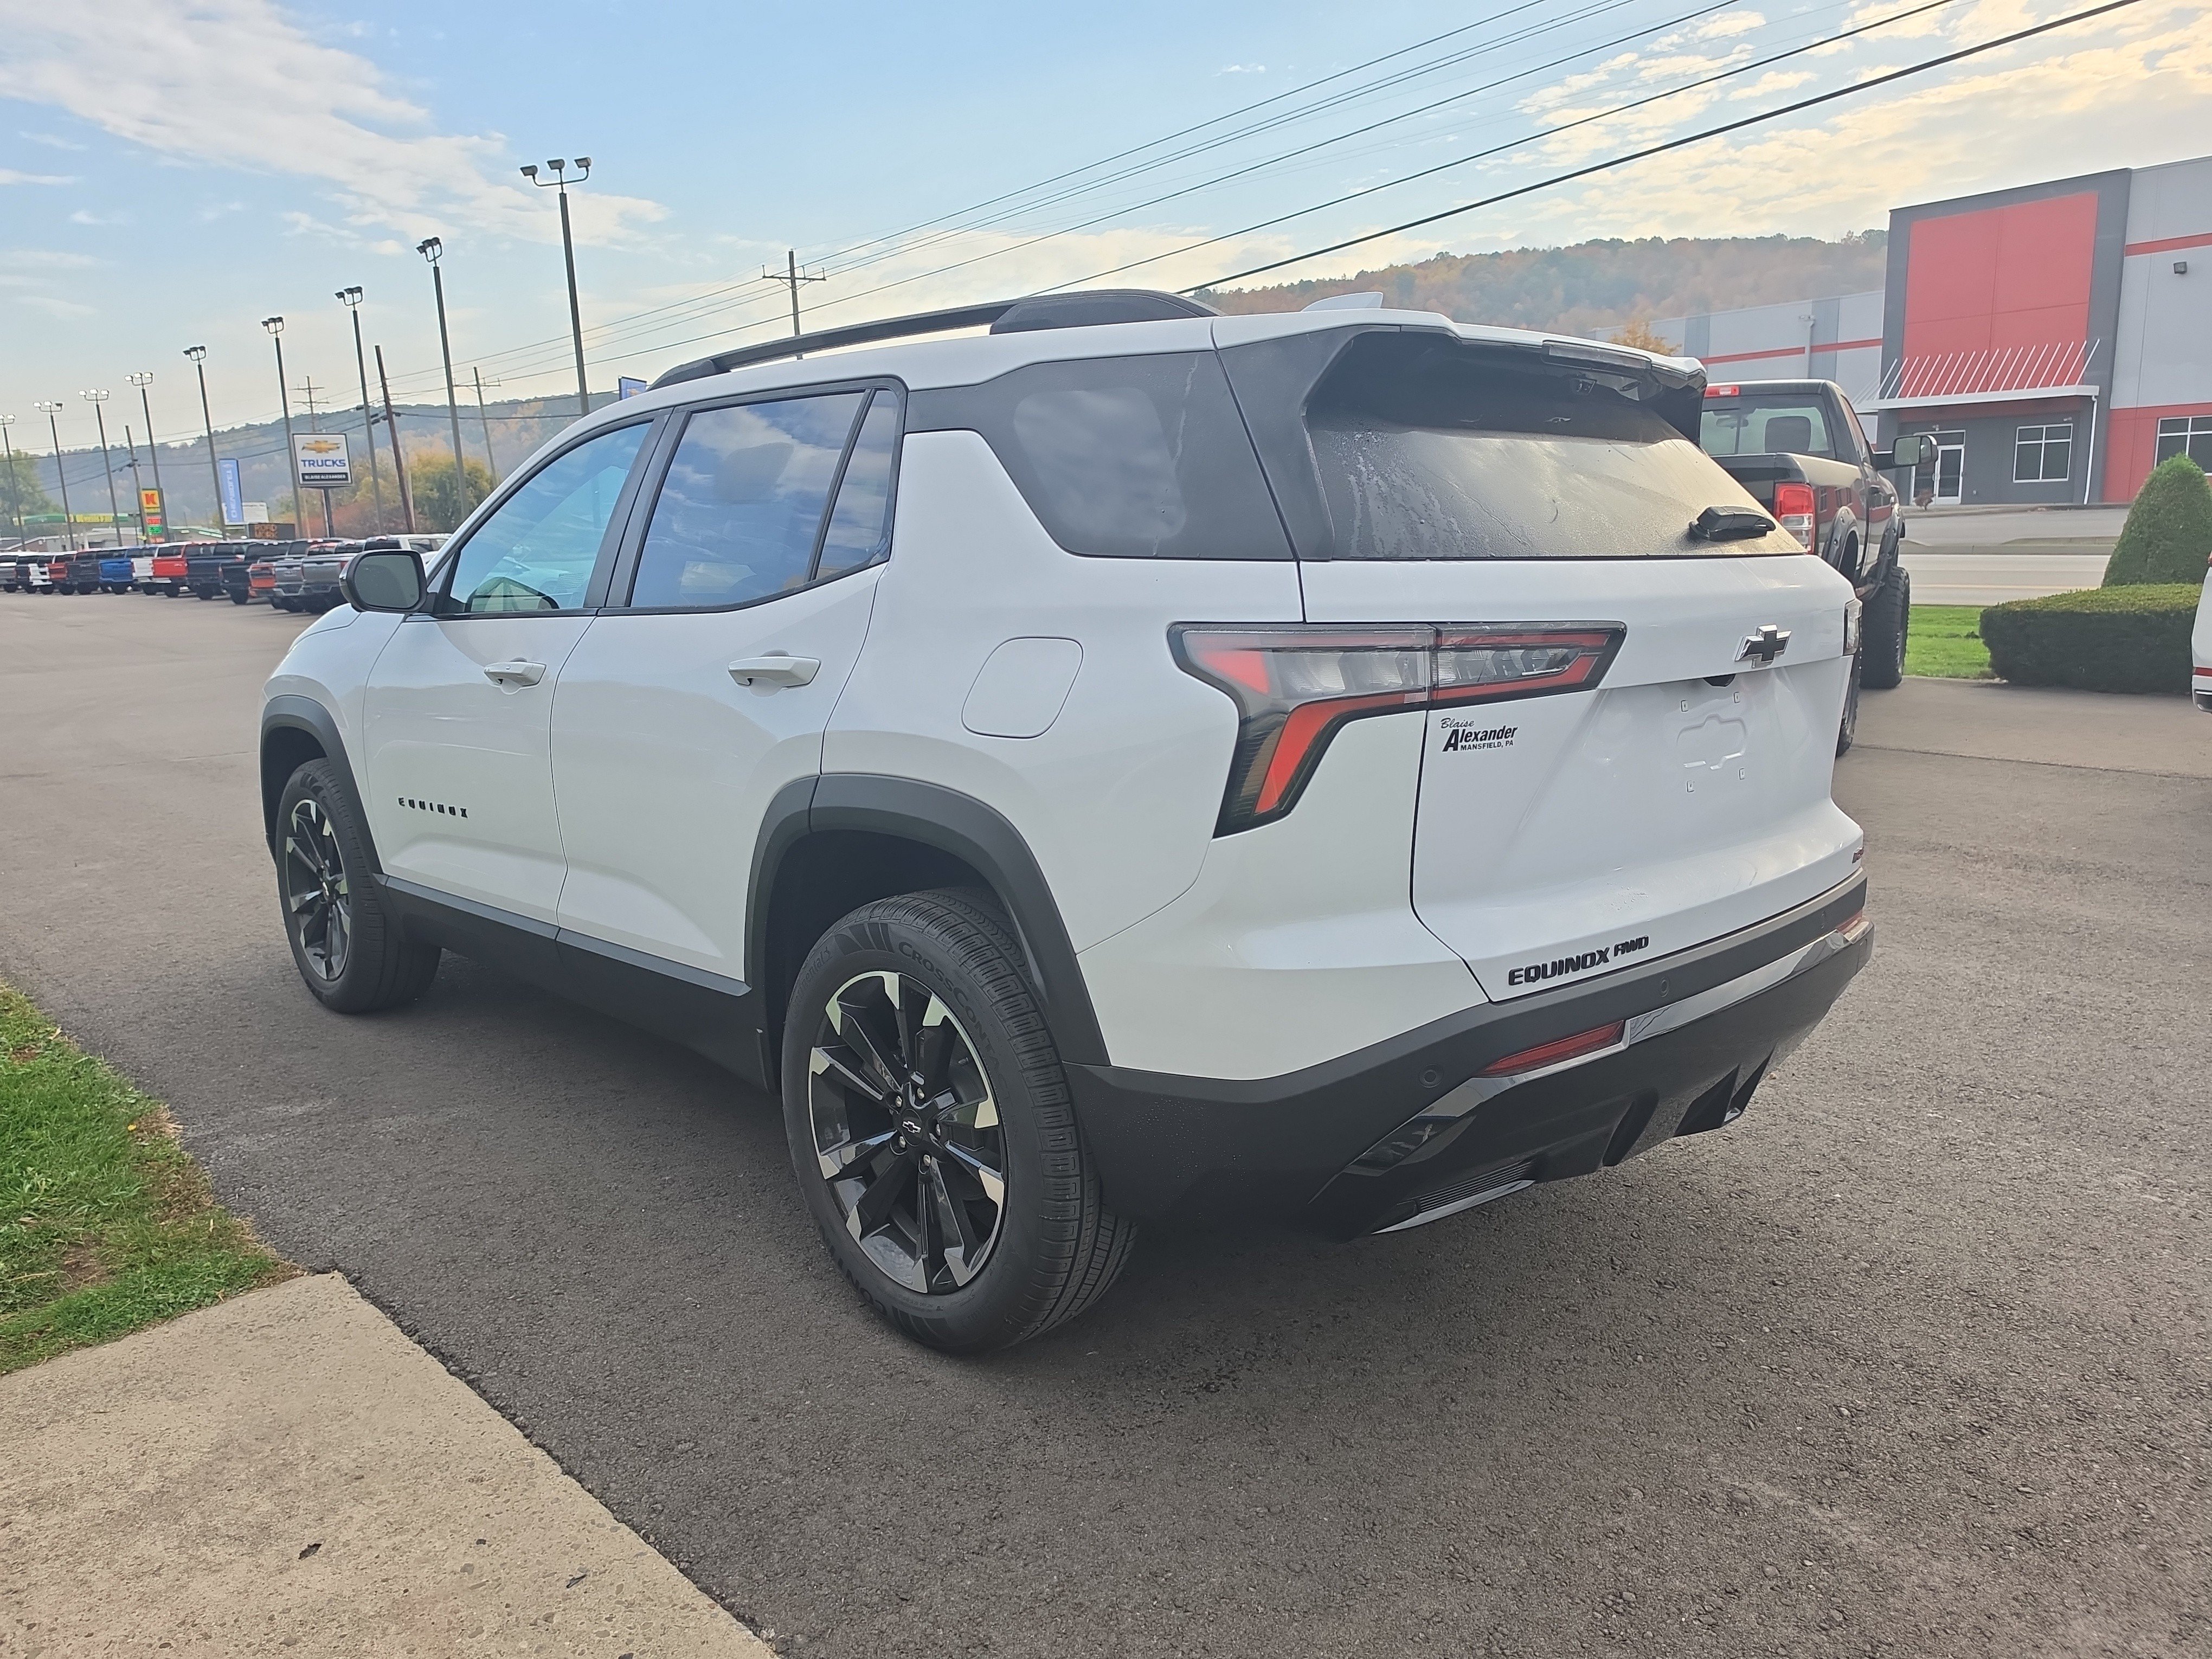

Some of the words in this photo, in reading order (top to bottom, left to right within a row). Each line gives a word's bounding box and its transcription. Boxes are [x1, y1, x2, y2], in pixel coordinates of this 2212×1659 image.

[301, 459, 346, 467] TRUCKS
[145, 494, 156, 505] K
[1440, 717, 1475, 729] Blaise
[1442, 725, 1519, 752] Alexander
[1461, 741, 1503, 751] MANSFIELD,
[398, 797, 468, 818] EQUINOX
[1508, 946, 1610, 986] EQUINOX
[1613, 935, 1649, 957] AWD
